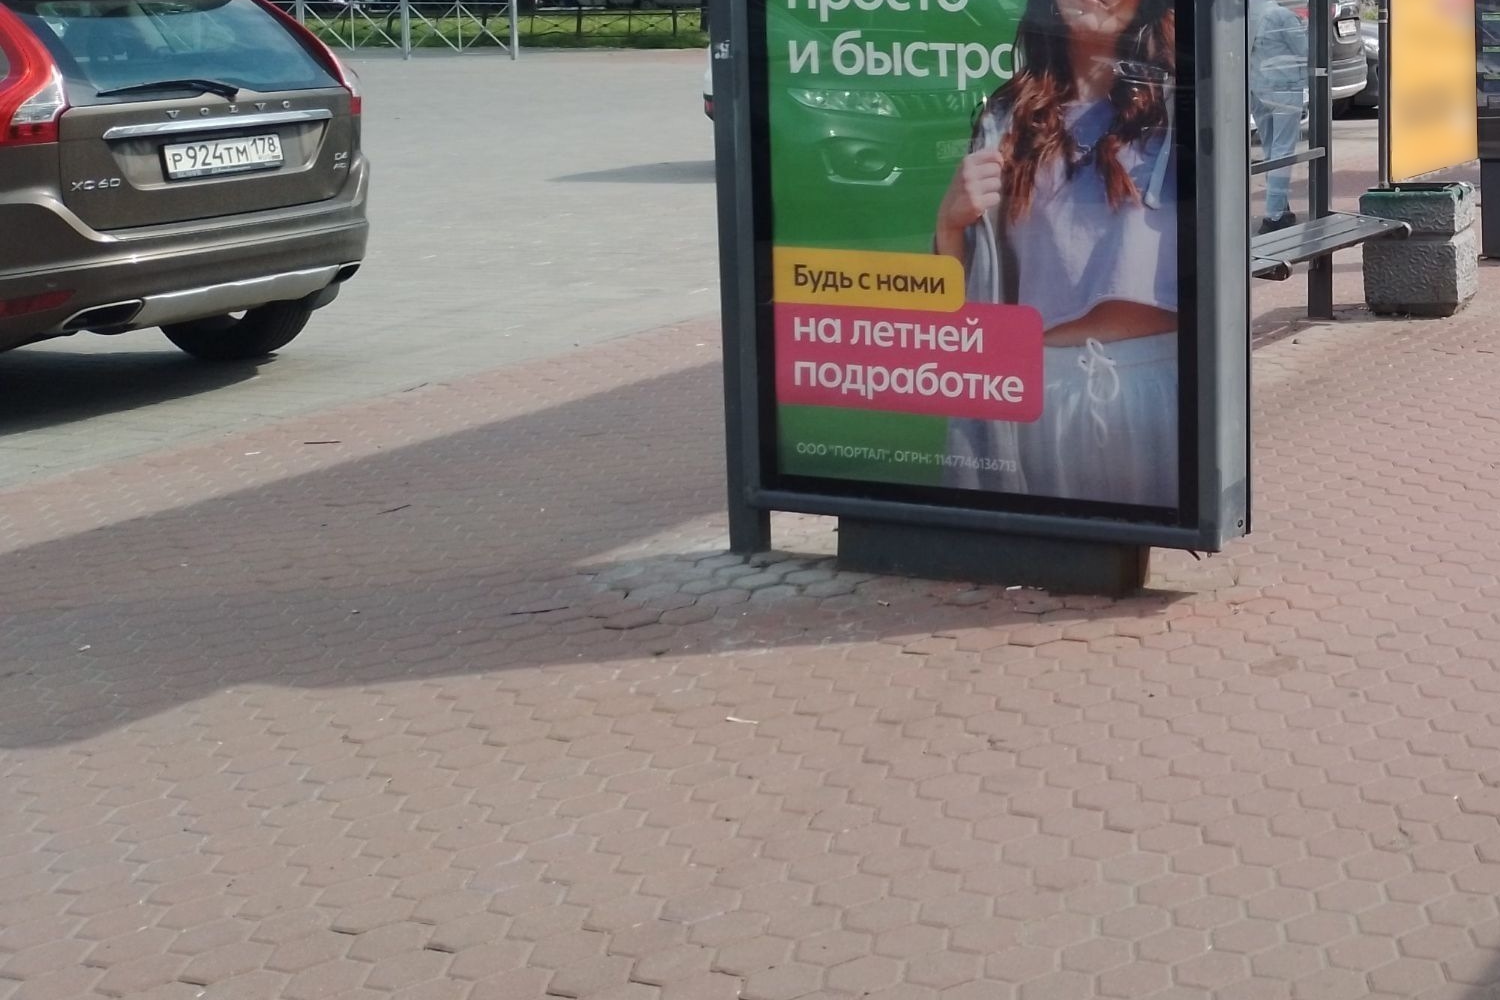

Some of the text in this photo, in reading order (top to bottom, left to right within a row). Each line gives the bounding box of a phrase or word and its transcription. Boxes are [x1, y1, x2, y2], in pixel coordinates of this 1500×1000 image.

[788, 40, 819, 75] и
[166, 100, 291, 118] VOLVO
[793, 264, 946, 295] Будь с нами
[793, 316, 984, 354] на летней
[793, 360, 1025, 404] подработке
[796, 442, 827, 456] ООО
[894, 450, 933, 464] ОГРН:
